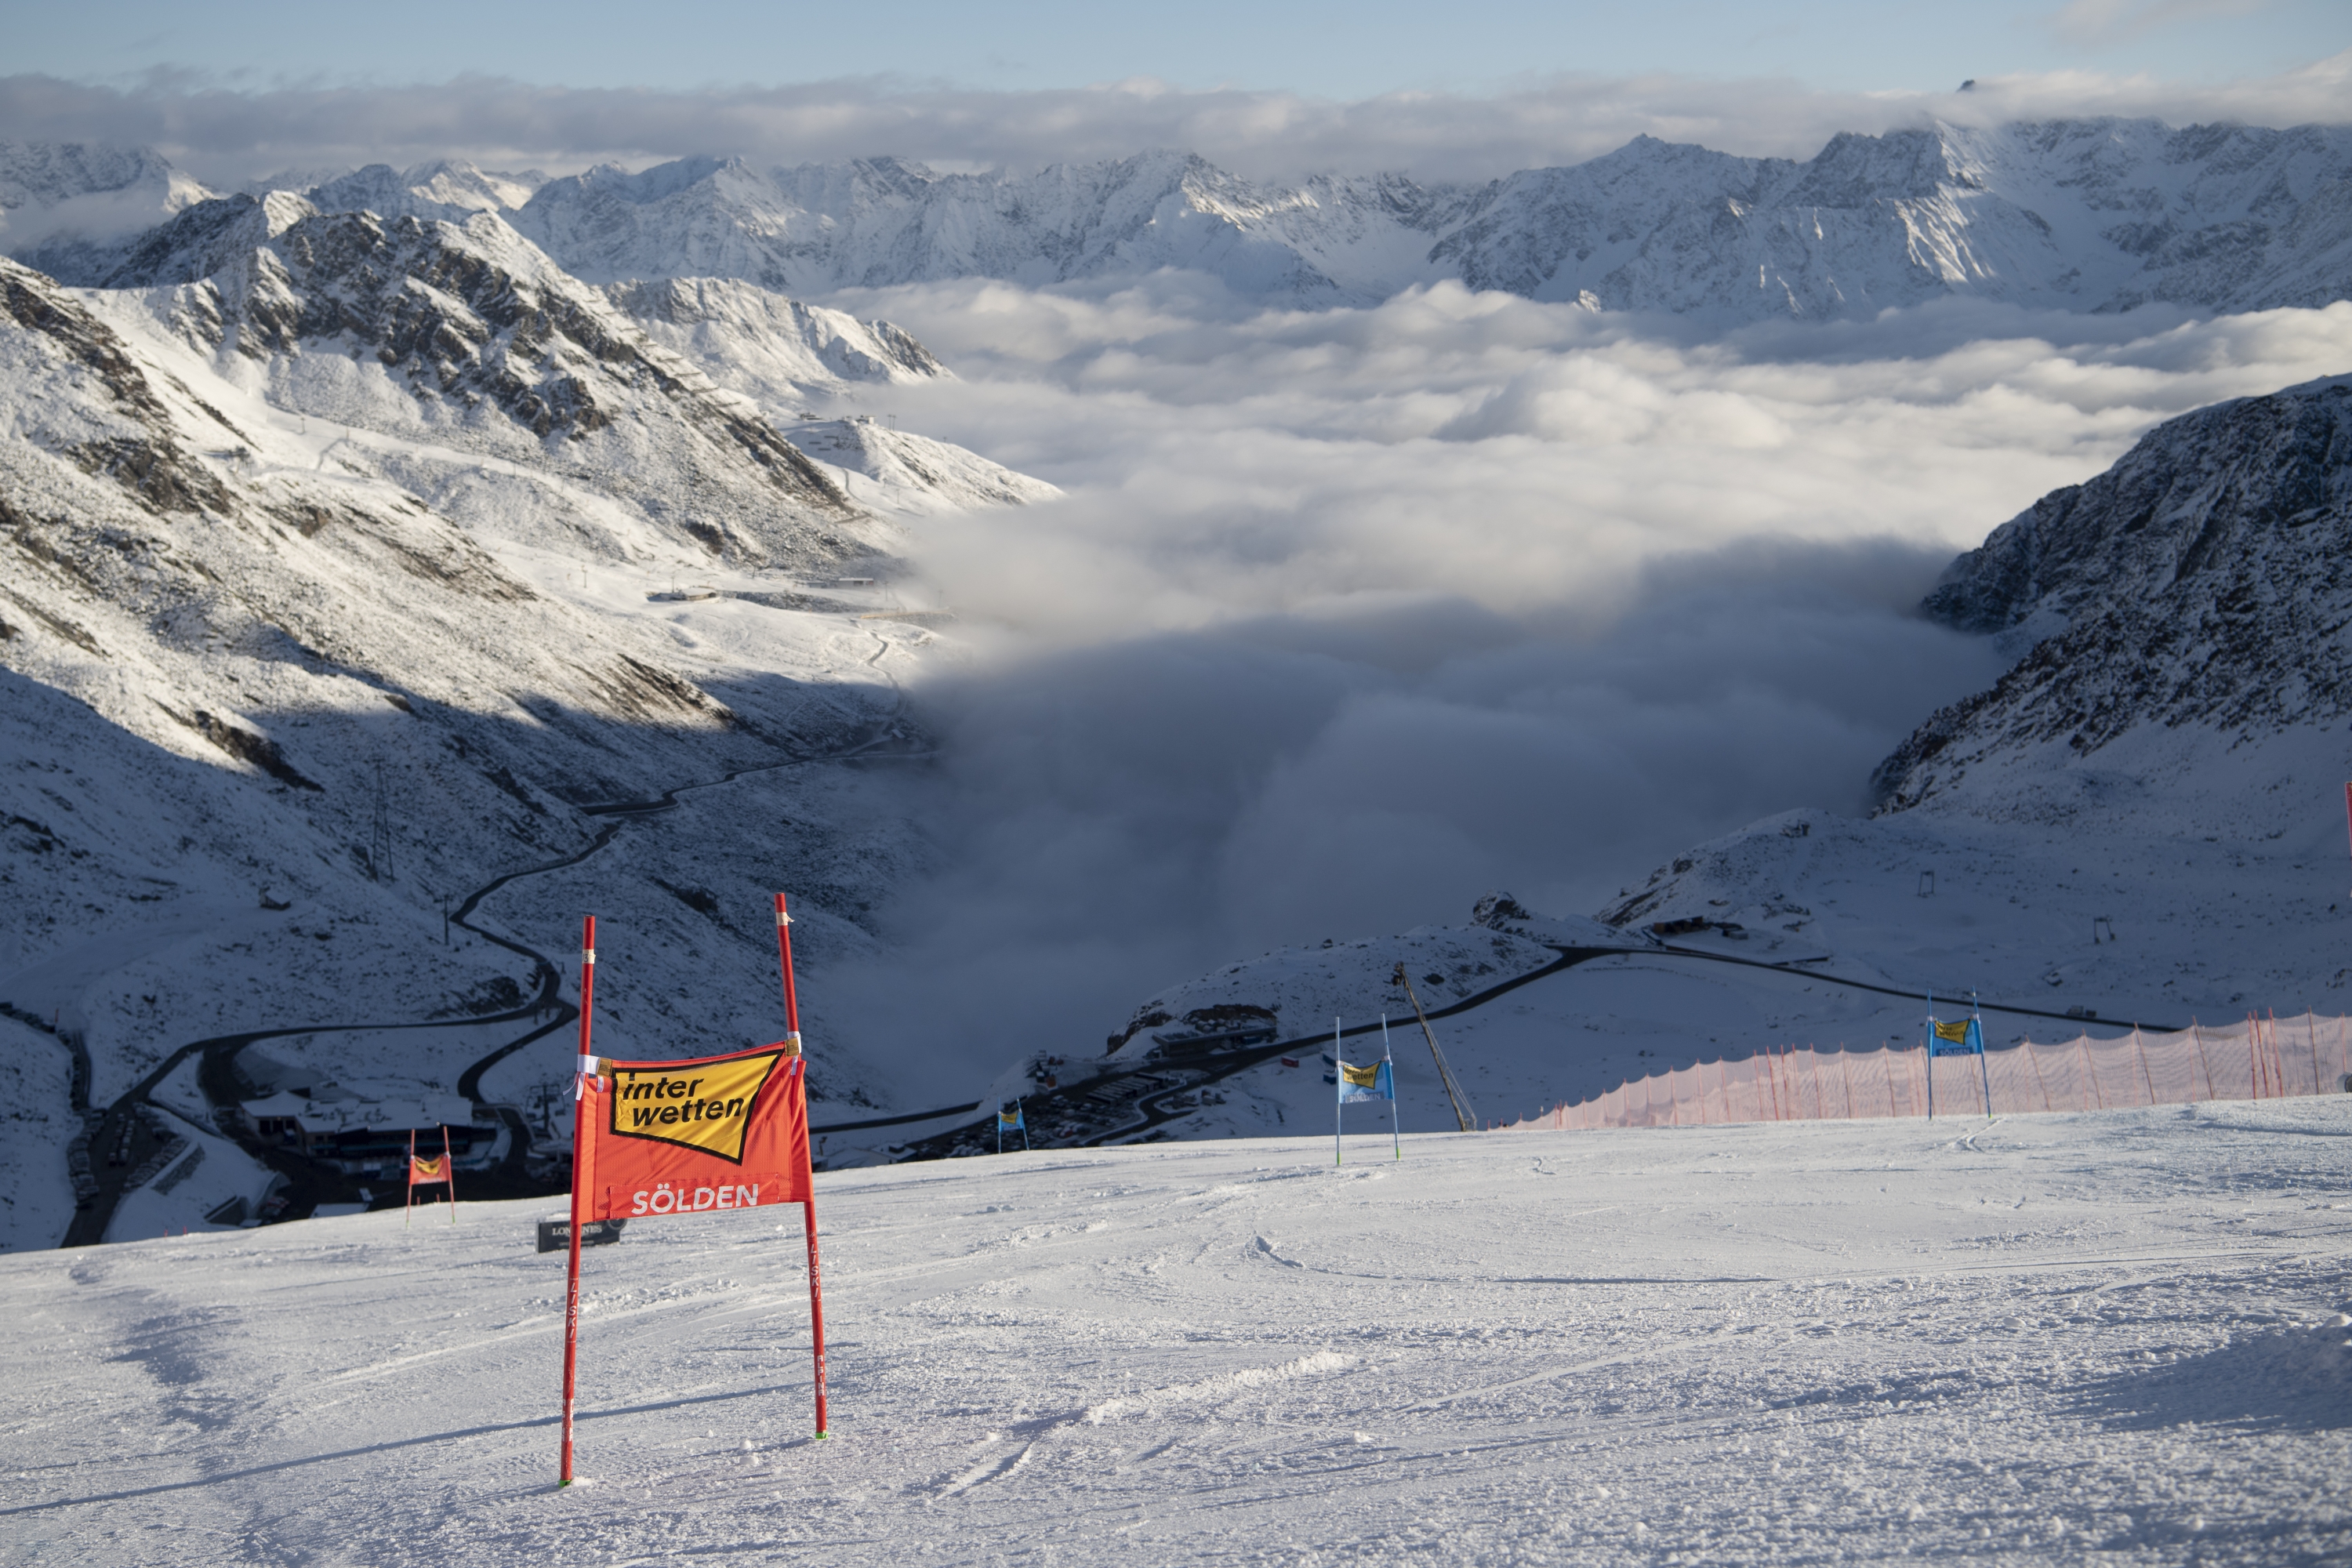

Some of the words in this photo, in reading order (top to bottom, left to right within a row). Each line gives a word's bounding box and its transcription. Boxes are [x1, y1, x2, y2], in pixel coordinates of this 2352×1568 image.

[623, 1074, 704, 1100] inter
[633, 1098, 744, 1127] wetten
[631, 1183, 758, 1214] SÖLDEN
[552, 1225, 602, 1236] LONNES
[811, 1244, 819, 1298] LISKI
[568, 1283, 577, 1338] LISKI
